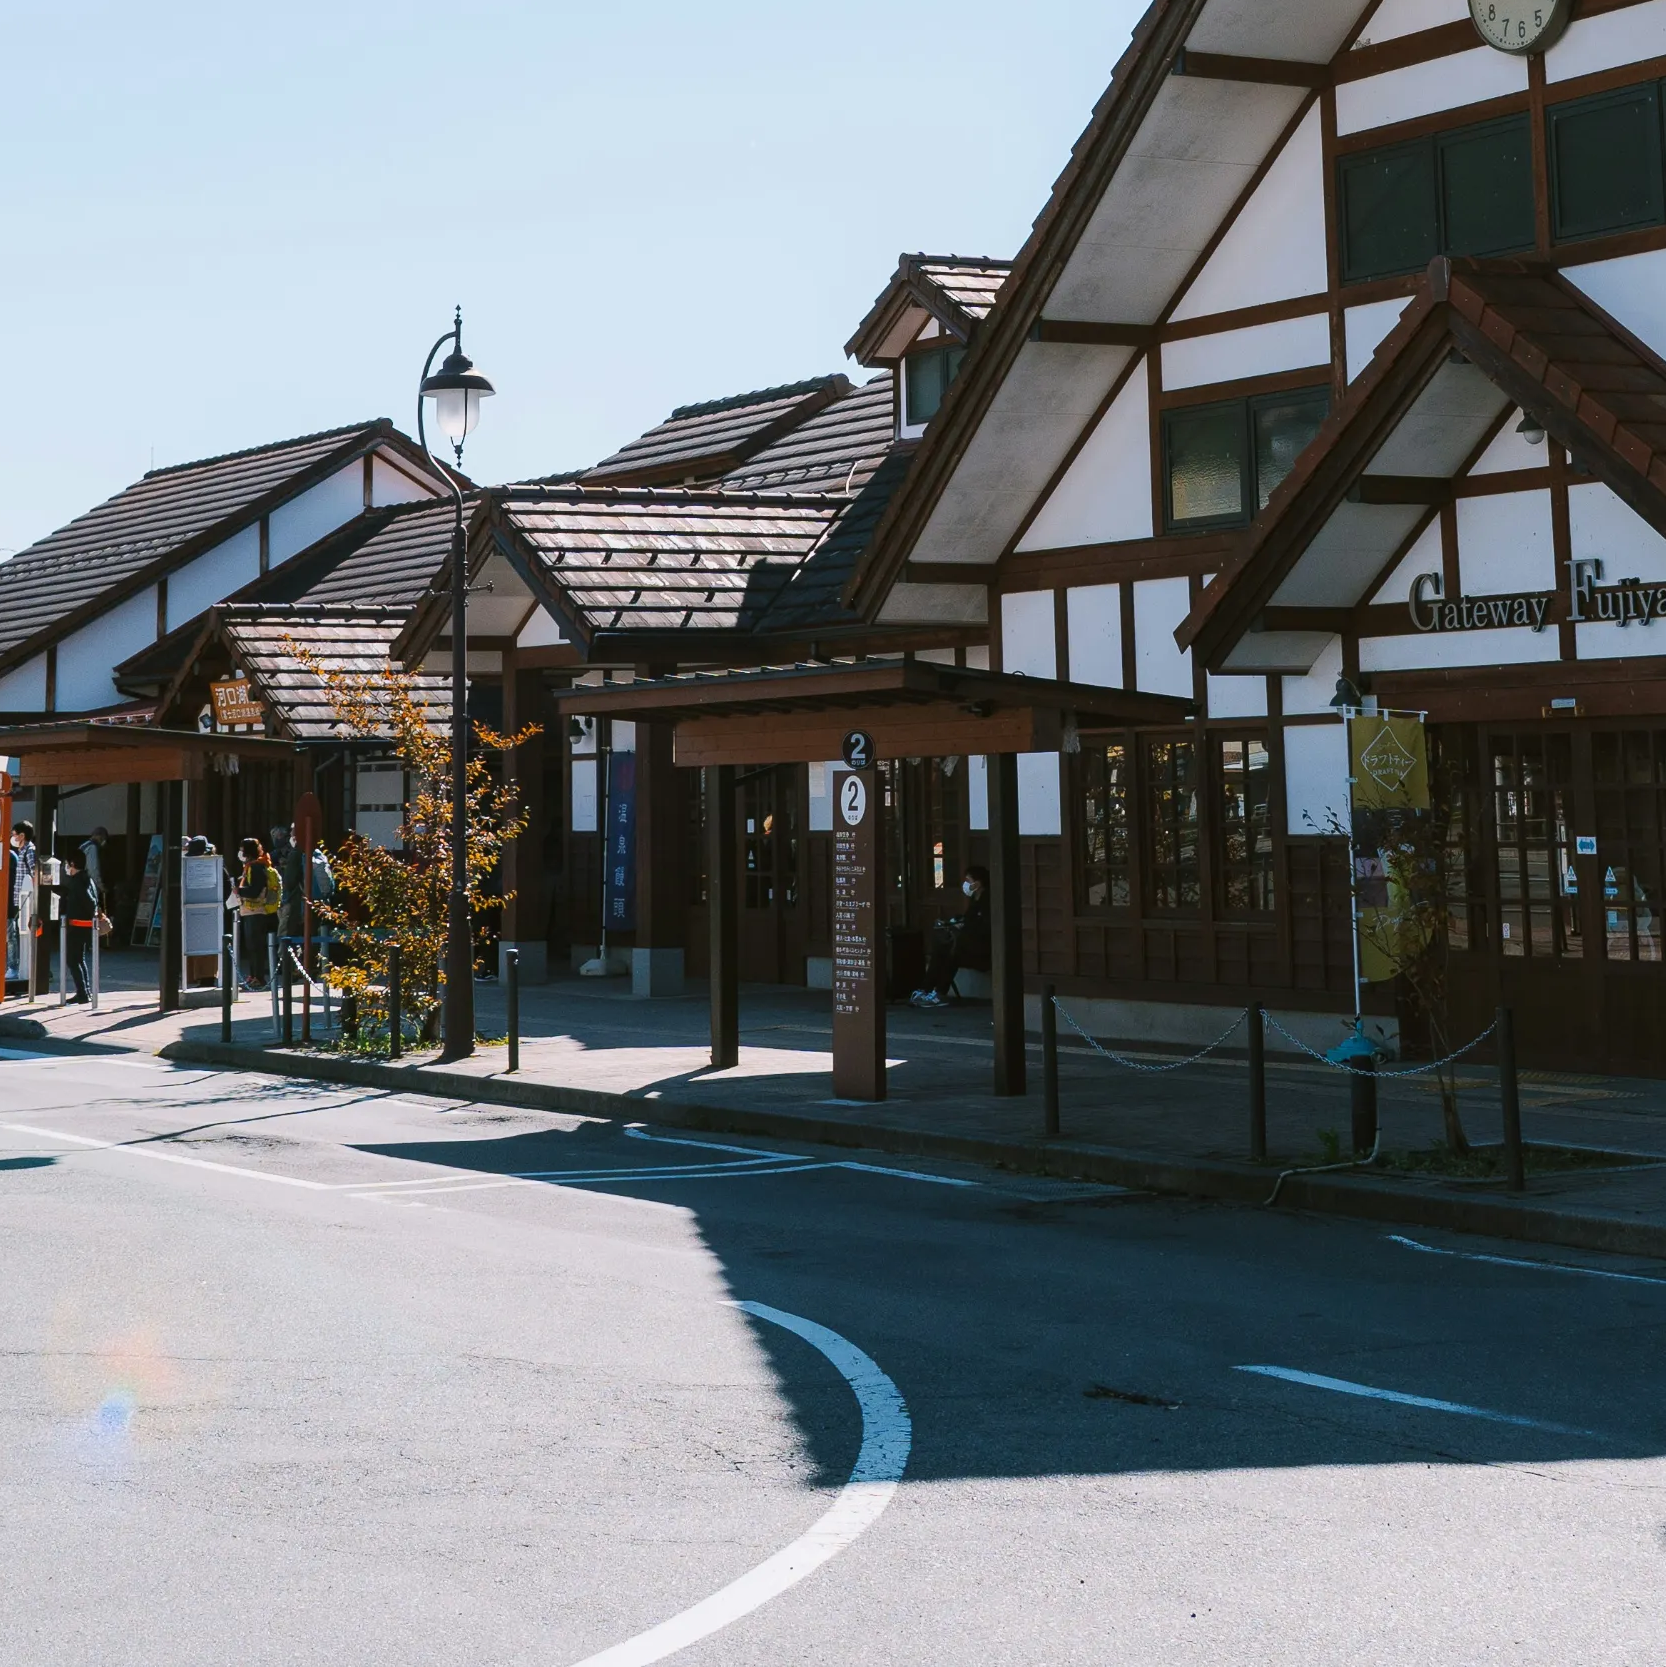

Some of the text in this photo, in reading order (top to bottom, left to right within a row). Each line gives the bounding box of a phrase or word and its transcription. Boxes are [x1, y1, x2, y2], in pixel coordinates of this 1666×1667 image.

[1488, 4, 1496, 21] 8
[1534, 9, 1542, 28] 5
[1502, 18, 1510, 37] 7
[1518, 20, 1526, 39] 6
[1408, 571, 1548, 633] Gateway
[214, 684, 252, 708] 河口湖
[850, 733, 866, 759] 2
[847, 780, 859, 812] 2
